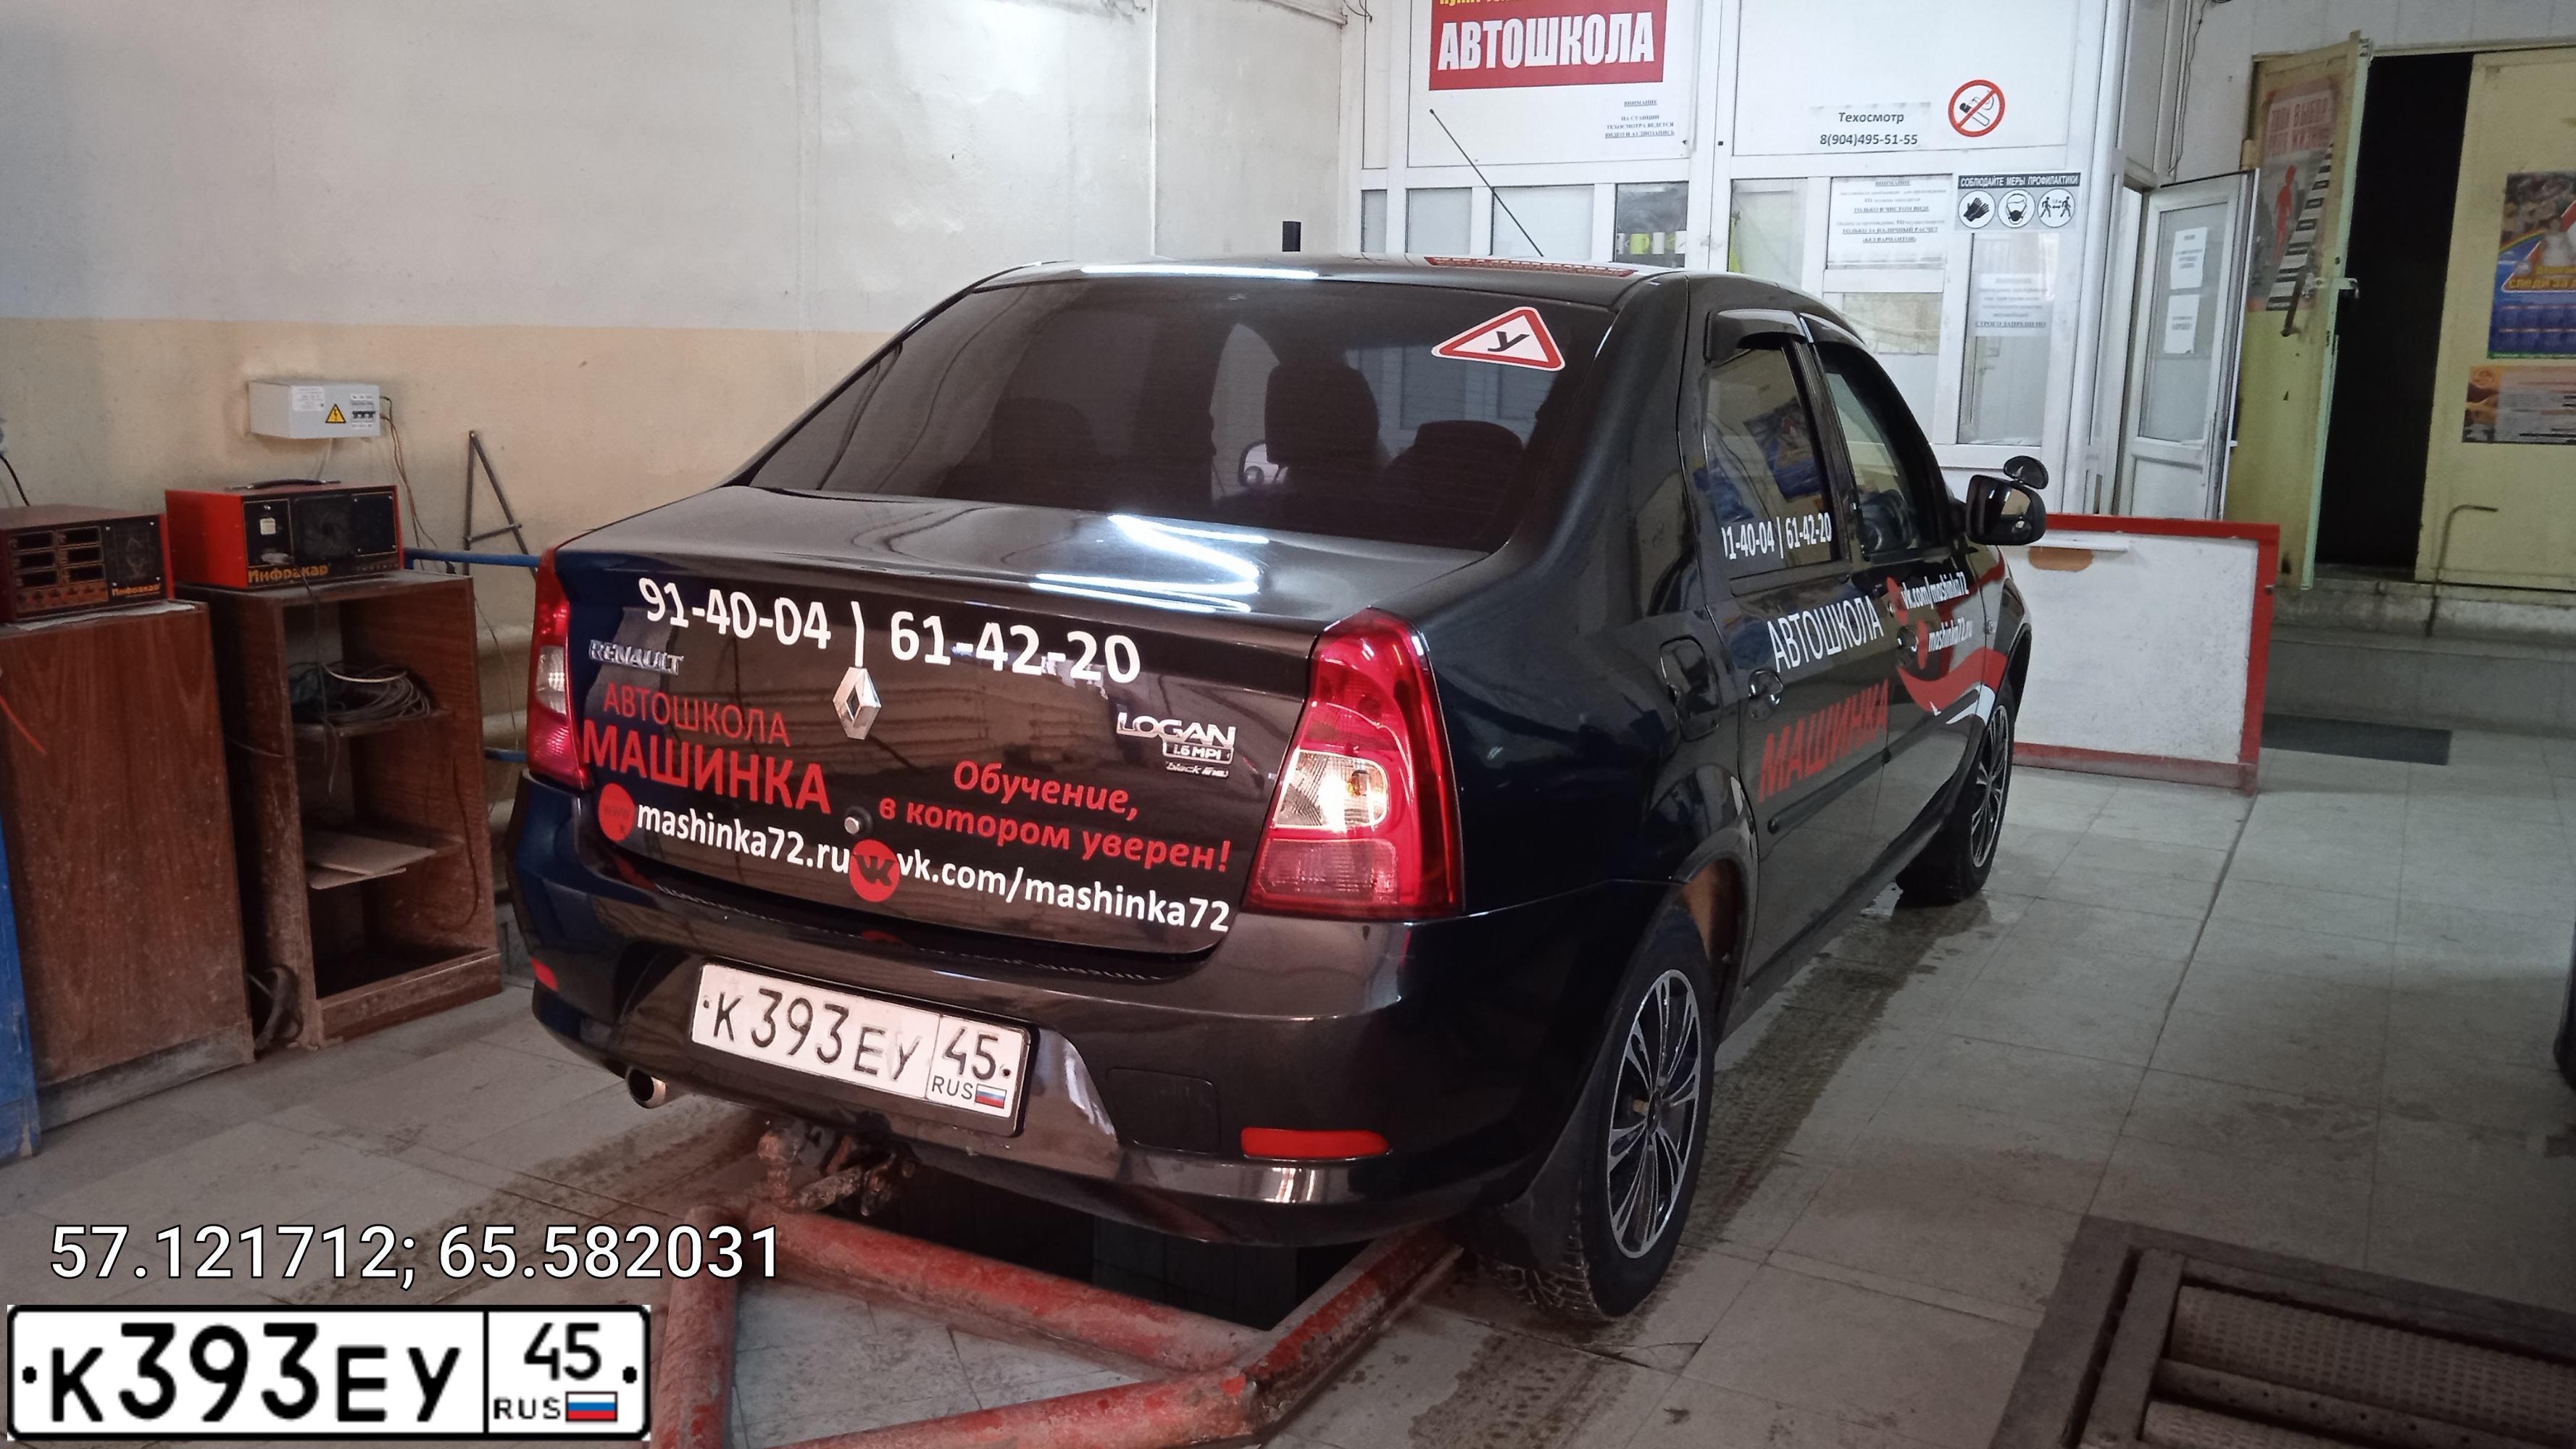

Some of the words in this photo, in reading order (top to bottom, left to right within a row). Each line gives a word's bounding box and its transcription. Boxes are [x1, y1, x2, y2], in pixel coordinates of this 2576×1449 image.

[1438, 12, 1654, 70] АВТОШКОЛА
[1820, 133, 1918, 146] 8(904)495-51-55
[1838, 112, 1904, 126] Техосмотр
[1961, 176, 2004, 187] СОБЛЮДАЙТЕ
[2006, 177, 2025, 185] МЕРЫ
[2028, 175, 2078, 185] ПРОФИЛАКТИКИ
[1488, 331, 1530, 352] У
[1785, 512, 1832, 549] 61-42-20
[588, 639, 684, 676] RENAULT
[638, 577, 832, 649] 91-40-04
[890, 611, 1141, 684] 61-42-20
[1767, 596, 1883, 673] АВТОШКОЛА
[603, 682, 791, 747] АВТОШКОЛА
[1117, 712, 1236, 748] LOGAN
[1758, 679, 1888, 804] МАШИНКА
[583, 719, 832, 814] МАШИНКА
[1173, 744, 1190, 756] 1.6
[1192, 748, 1221, 760] MPI
[954, 760, 1139, 821] Обучение,
[637, 801, 851, 874] mashinka72.ru
[879, 798, 896, 819] в
[906, 803, 1070, 850] котором
[1081, 830, 1230, 872] уверен!
[896, 848, 1230, 933] vk.com/mashinka72
[943, 1027, 999, 1080] 45
[931, 1076, 973, 1101] RUS
